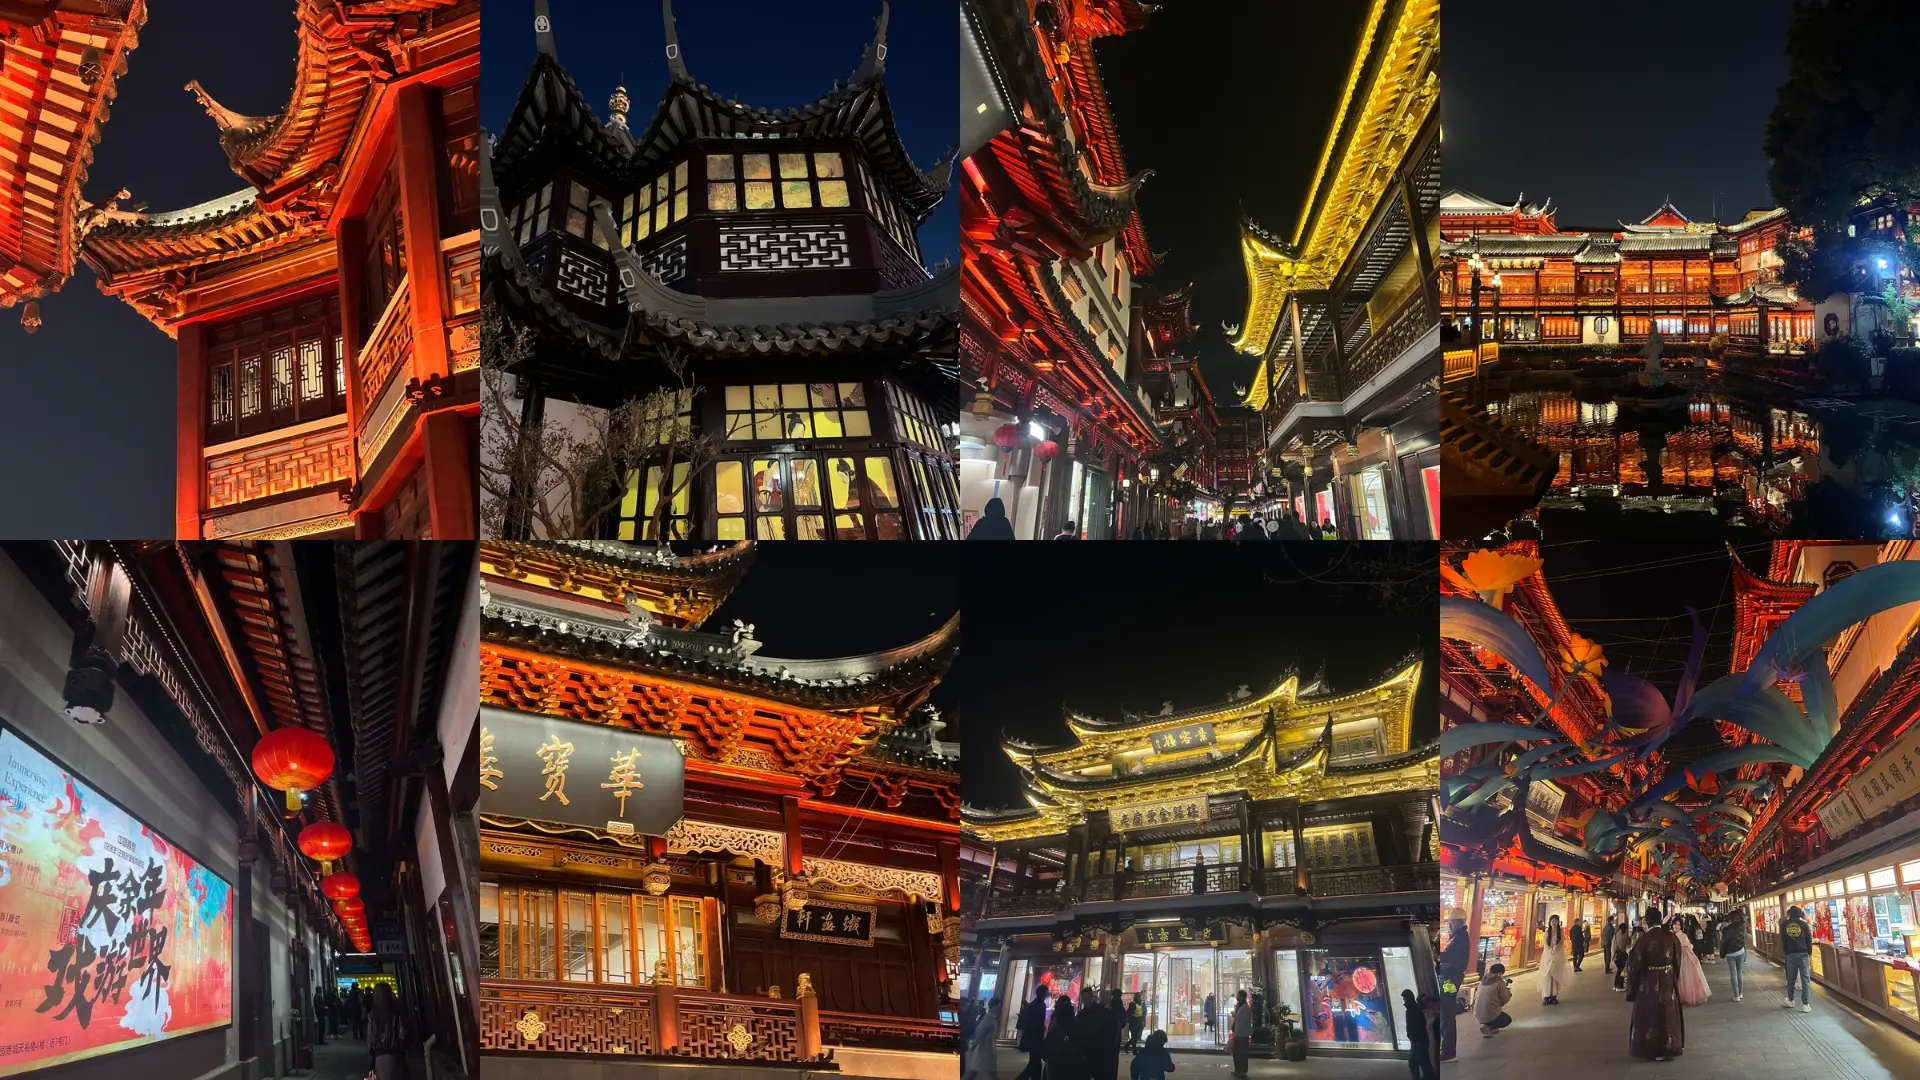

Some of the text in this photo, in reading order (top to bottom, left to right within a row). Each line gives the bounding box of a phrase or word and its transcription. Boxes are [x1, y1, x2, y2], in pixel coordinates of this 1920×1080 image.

[8, 754, 47, 787] Immersive
[1, 787, 27, 811] Realm
[4, 771, 46, 804] Experience
